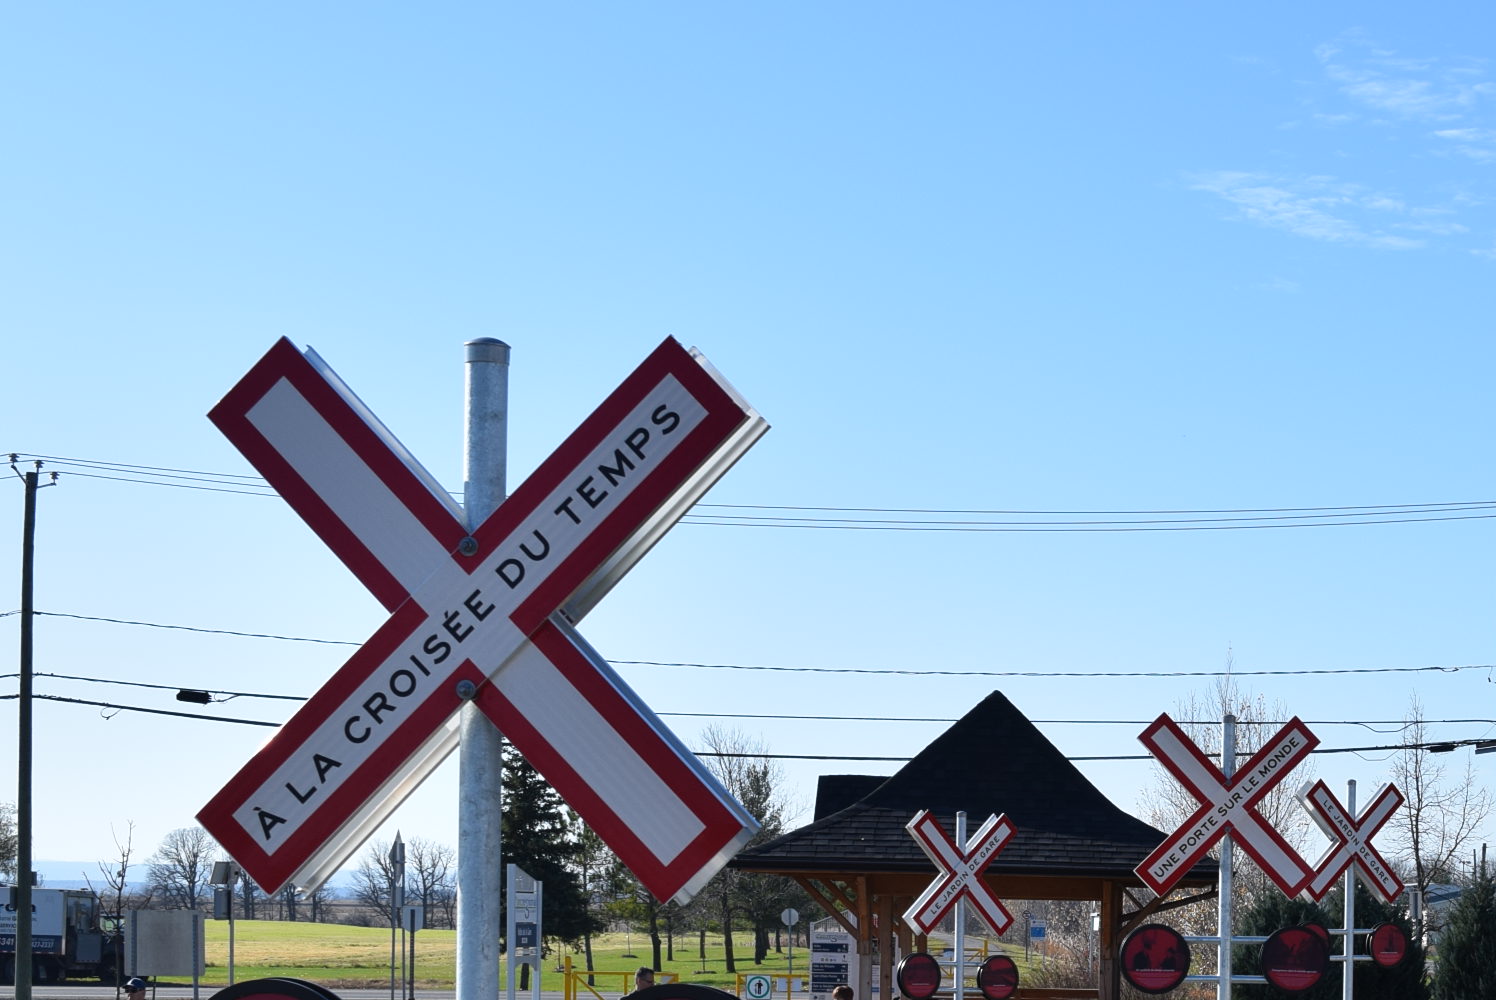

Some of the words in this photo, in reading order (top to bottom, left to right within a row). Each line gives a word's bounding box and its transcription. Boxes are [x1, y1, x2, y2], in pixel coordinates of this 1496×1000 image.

[253, 806, 286, 841] À
[286, 752, 341, 803] LA
[344, 589, 496, 744] CROISÉE
[496, 529, 551, 589] DU
[555, 403, 681, 525] TEMPS
[1154, 854, 1180, 878] UNE
[1179, 816, 1218, 854] PORTE
[1218, 792, 1243, 816] SUR
[1242, 776, 1259, 793] LE
[1258, 737, 1300, 778] MONDE
[1323, 800, 1334, 812] LE
[1334, 815, 1359, 846] JARDIN
[1360, 847, 1370, 860] DE
[1370, 860, 1388, 884] GARE
[930, 902, 941, 914] LE
[943, 872, 969, 901] JARDIN
[969, 859, 980, 870] DE
[980, 836, 1000, 858] GARE
